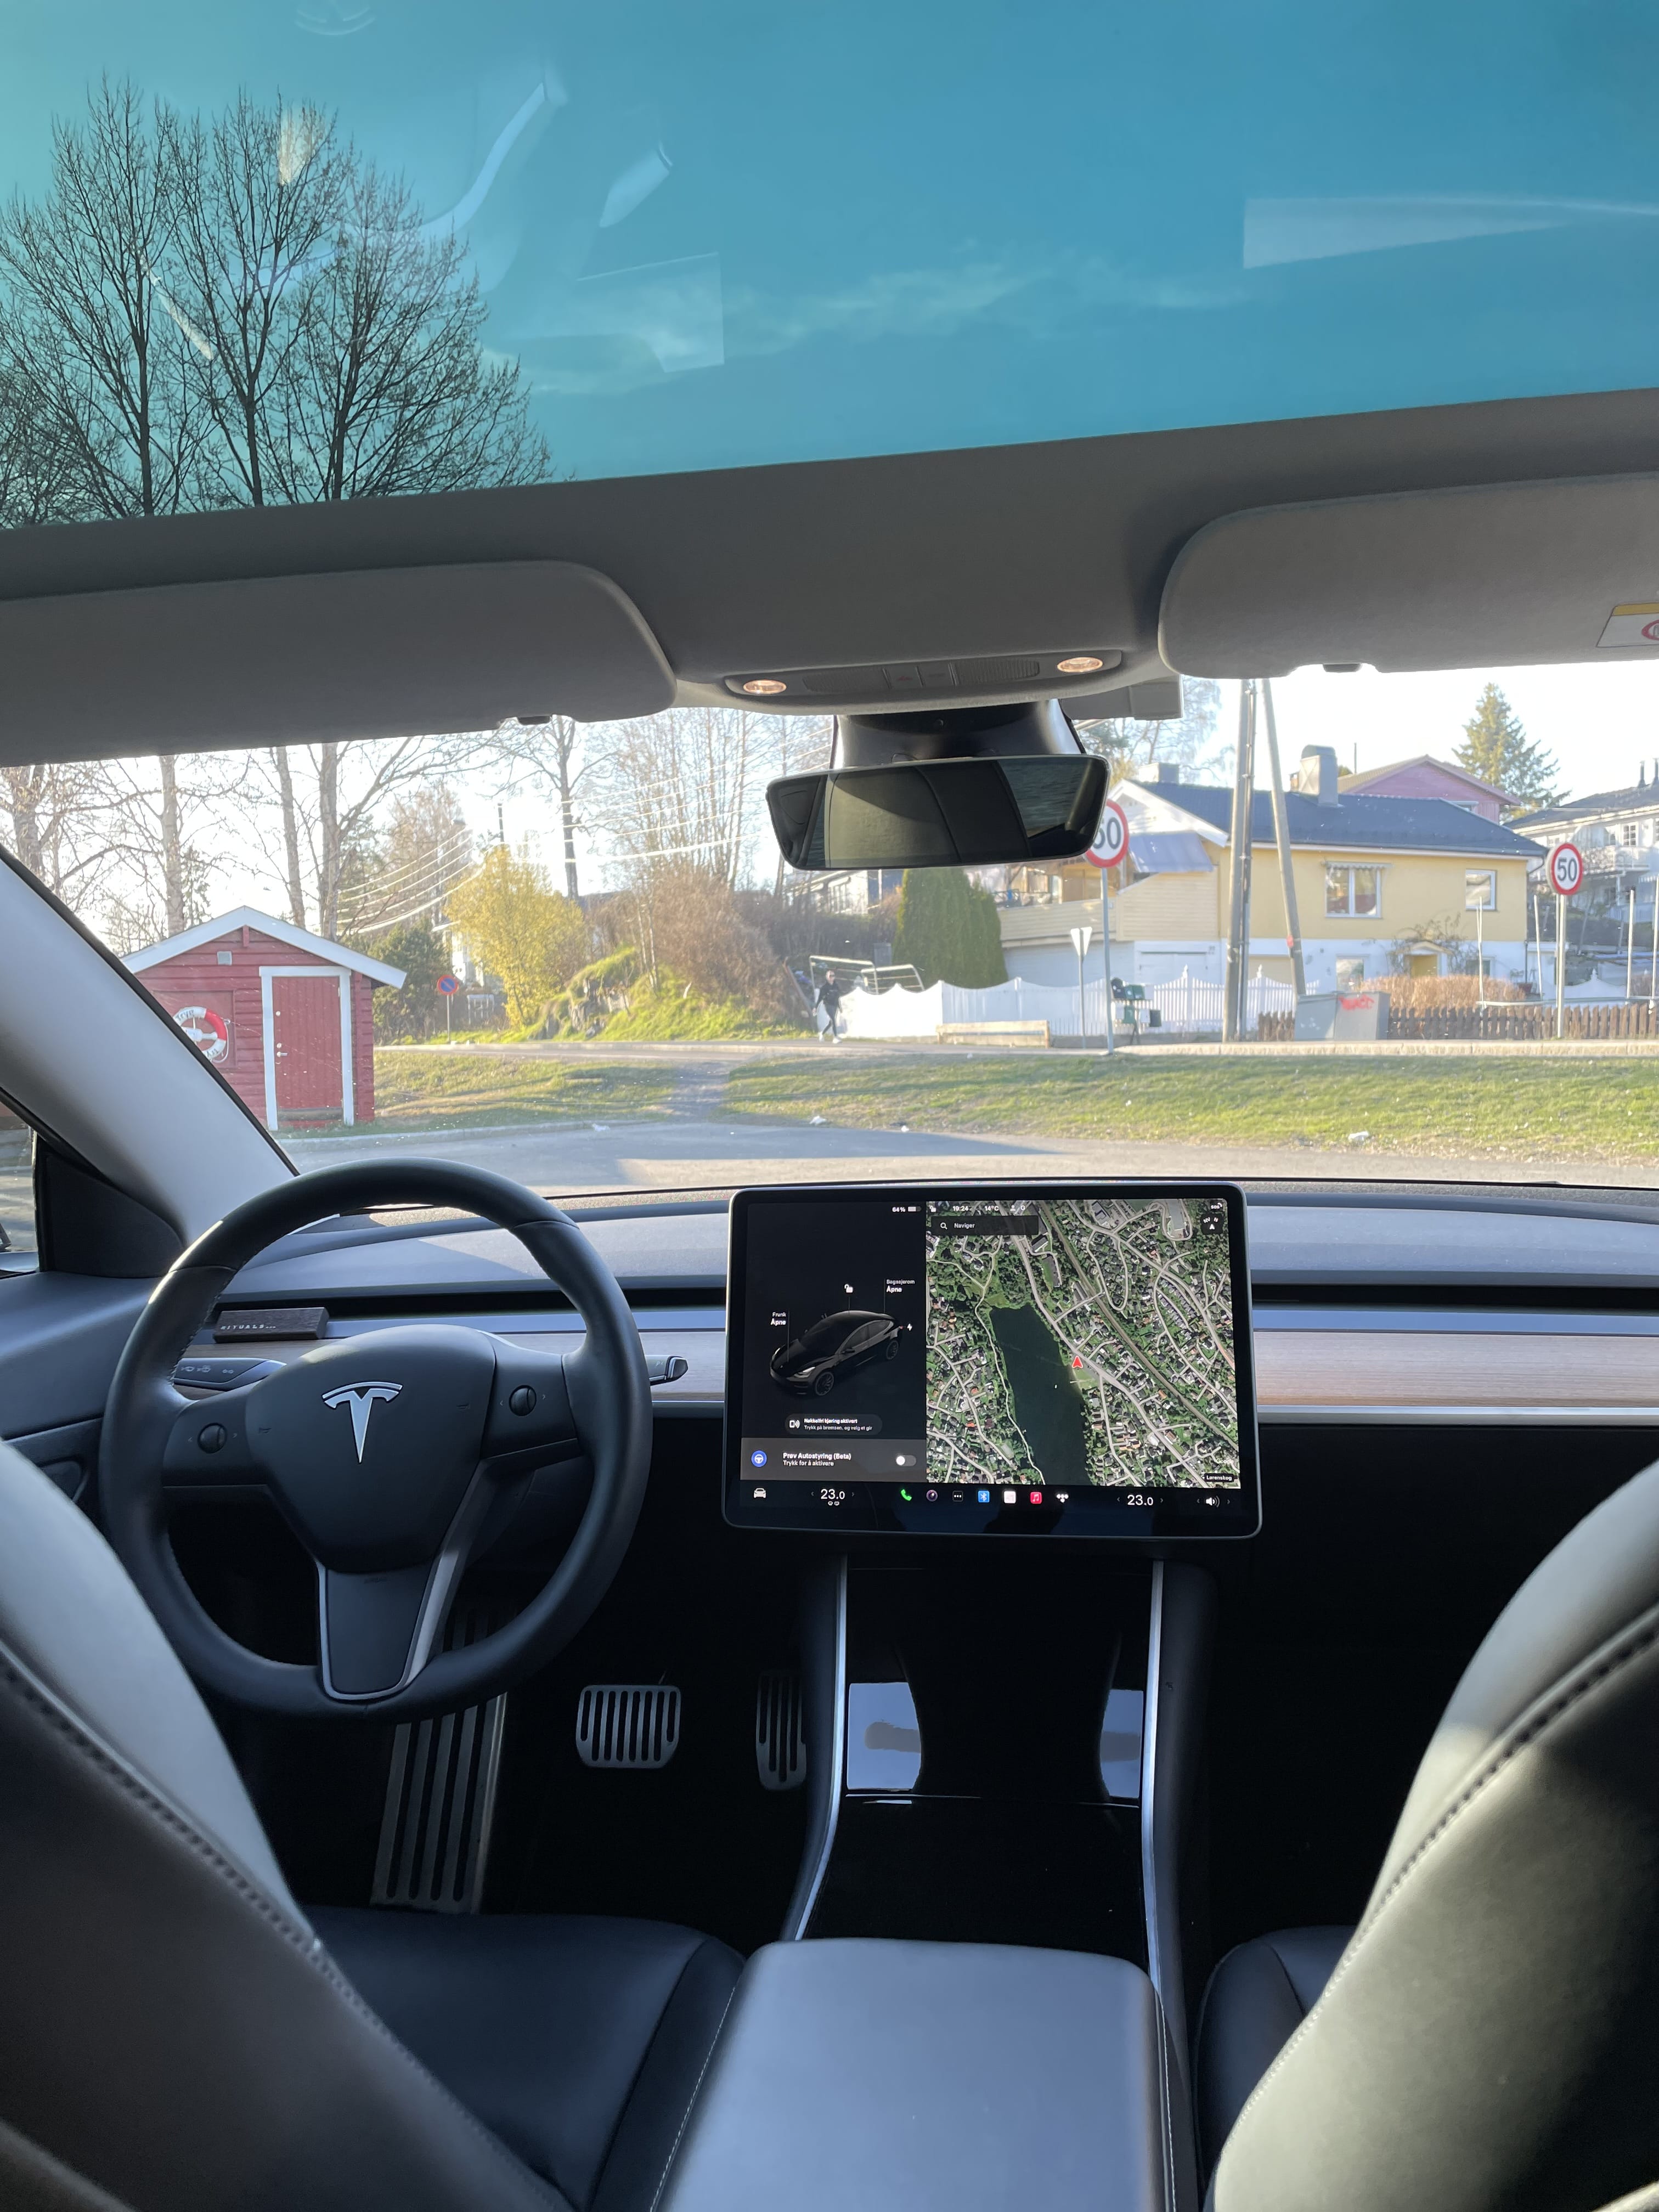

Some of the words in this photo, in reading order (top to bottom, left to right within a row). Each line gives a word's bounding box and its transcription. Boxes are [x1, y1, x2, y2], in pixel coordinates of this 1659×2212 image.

[1558, 857, 1577, 882] 50
[820, 1488, 845, 1499] 23.0
[1127, 1494, 1154, 1506] 23.0
